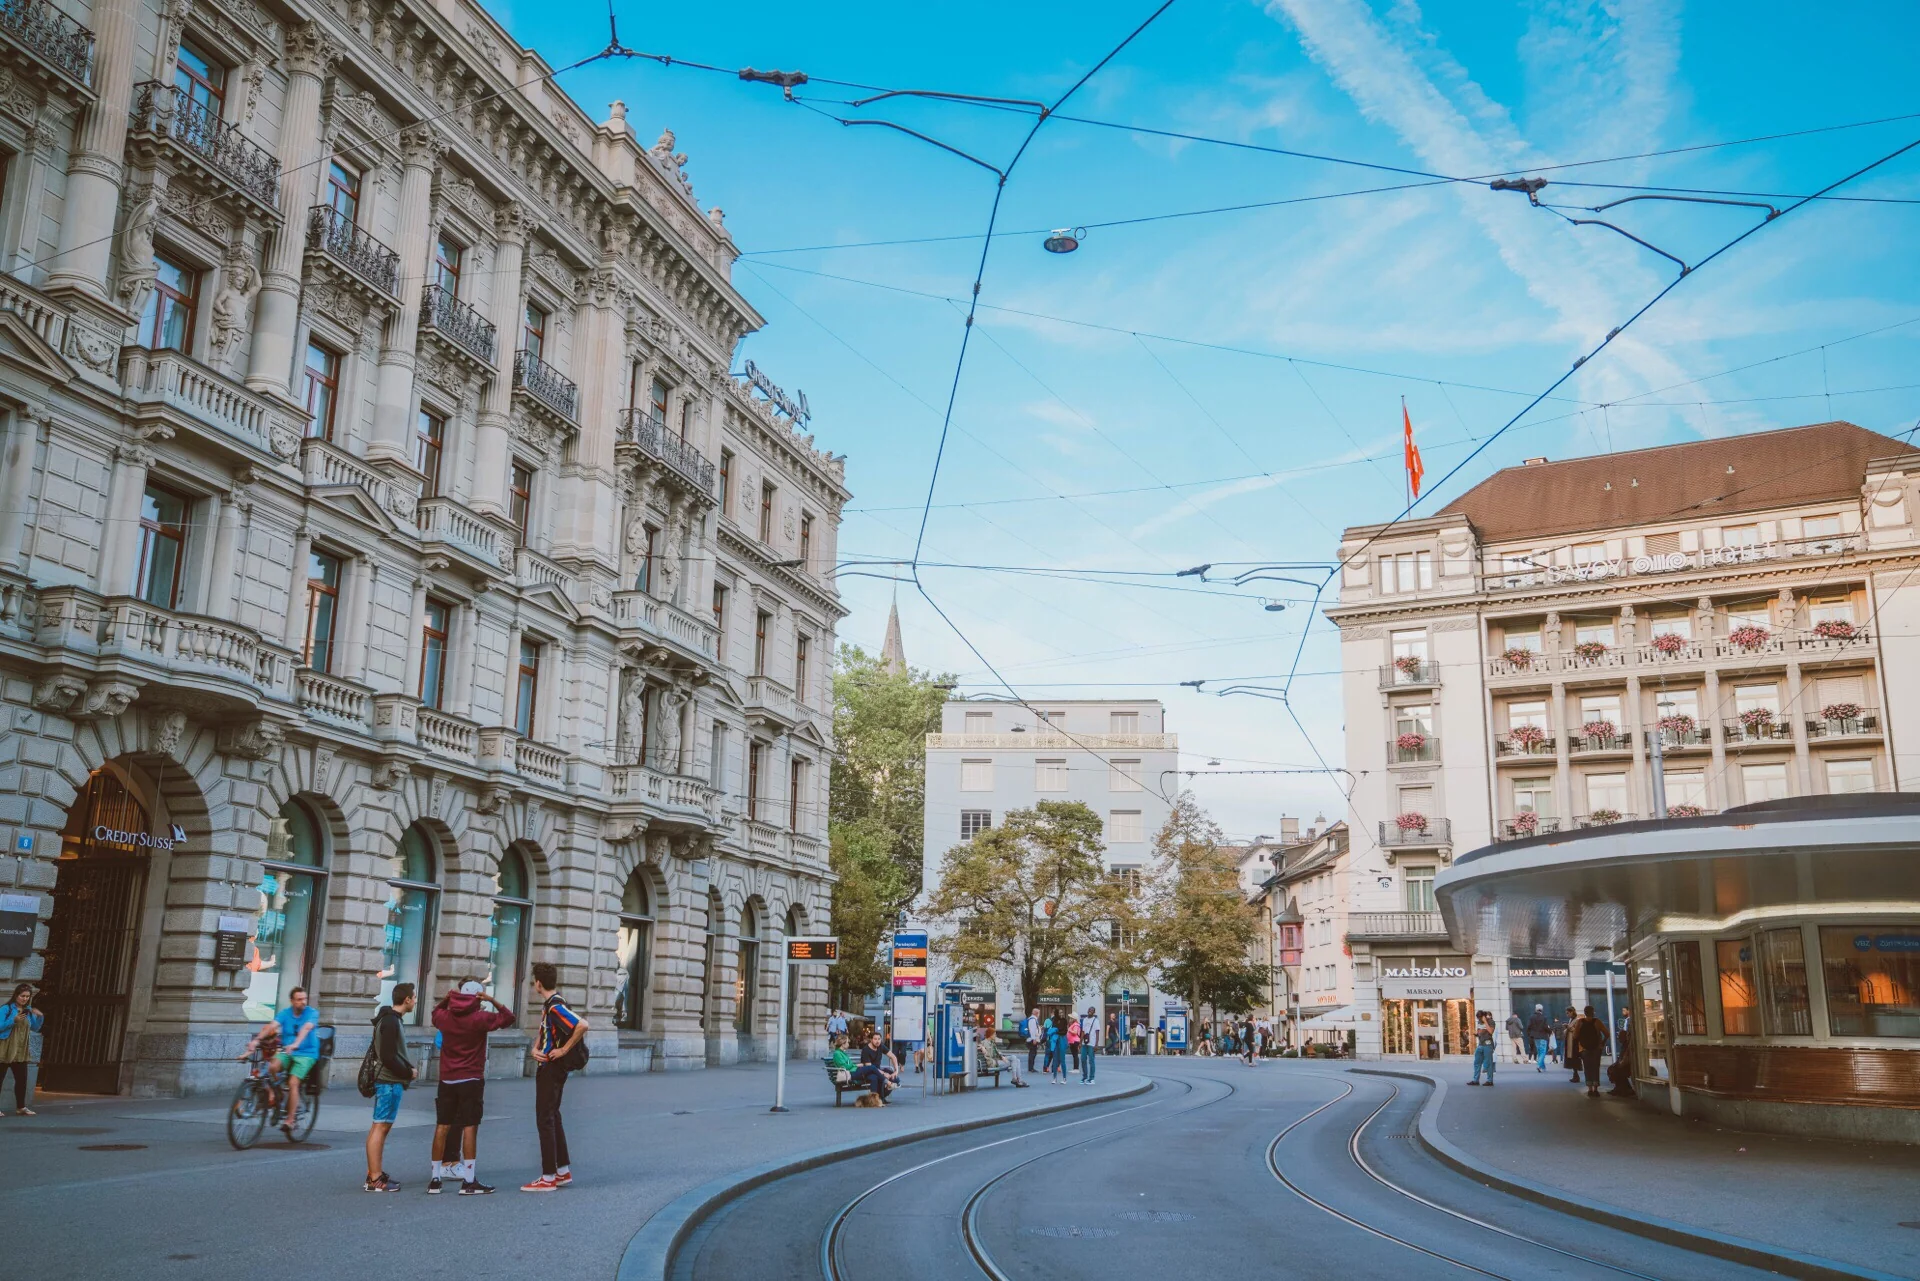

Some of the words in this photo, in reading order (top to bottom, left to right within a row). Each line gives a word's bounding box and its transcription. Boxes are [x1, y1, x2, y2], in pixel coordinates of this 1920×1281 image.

[1547, 559, 1624, 582] SAVOY
[1700, 541, 1781, 569] HOTEL
[95, 825, 138, 845] CREDIT
[138, 832, 175, 851] SUISSE
[1384, 967, 1467, 977] MARSANO
[1509, 969, 1534, 977] HARRY
[1534, 969, 1569, 977] WINSTON
